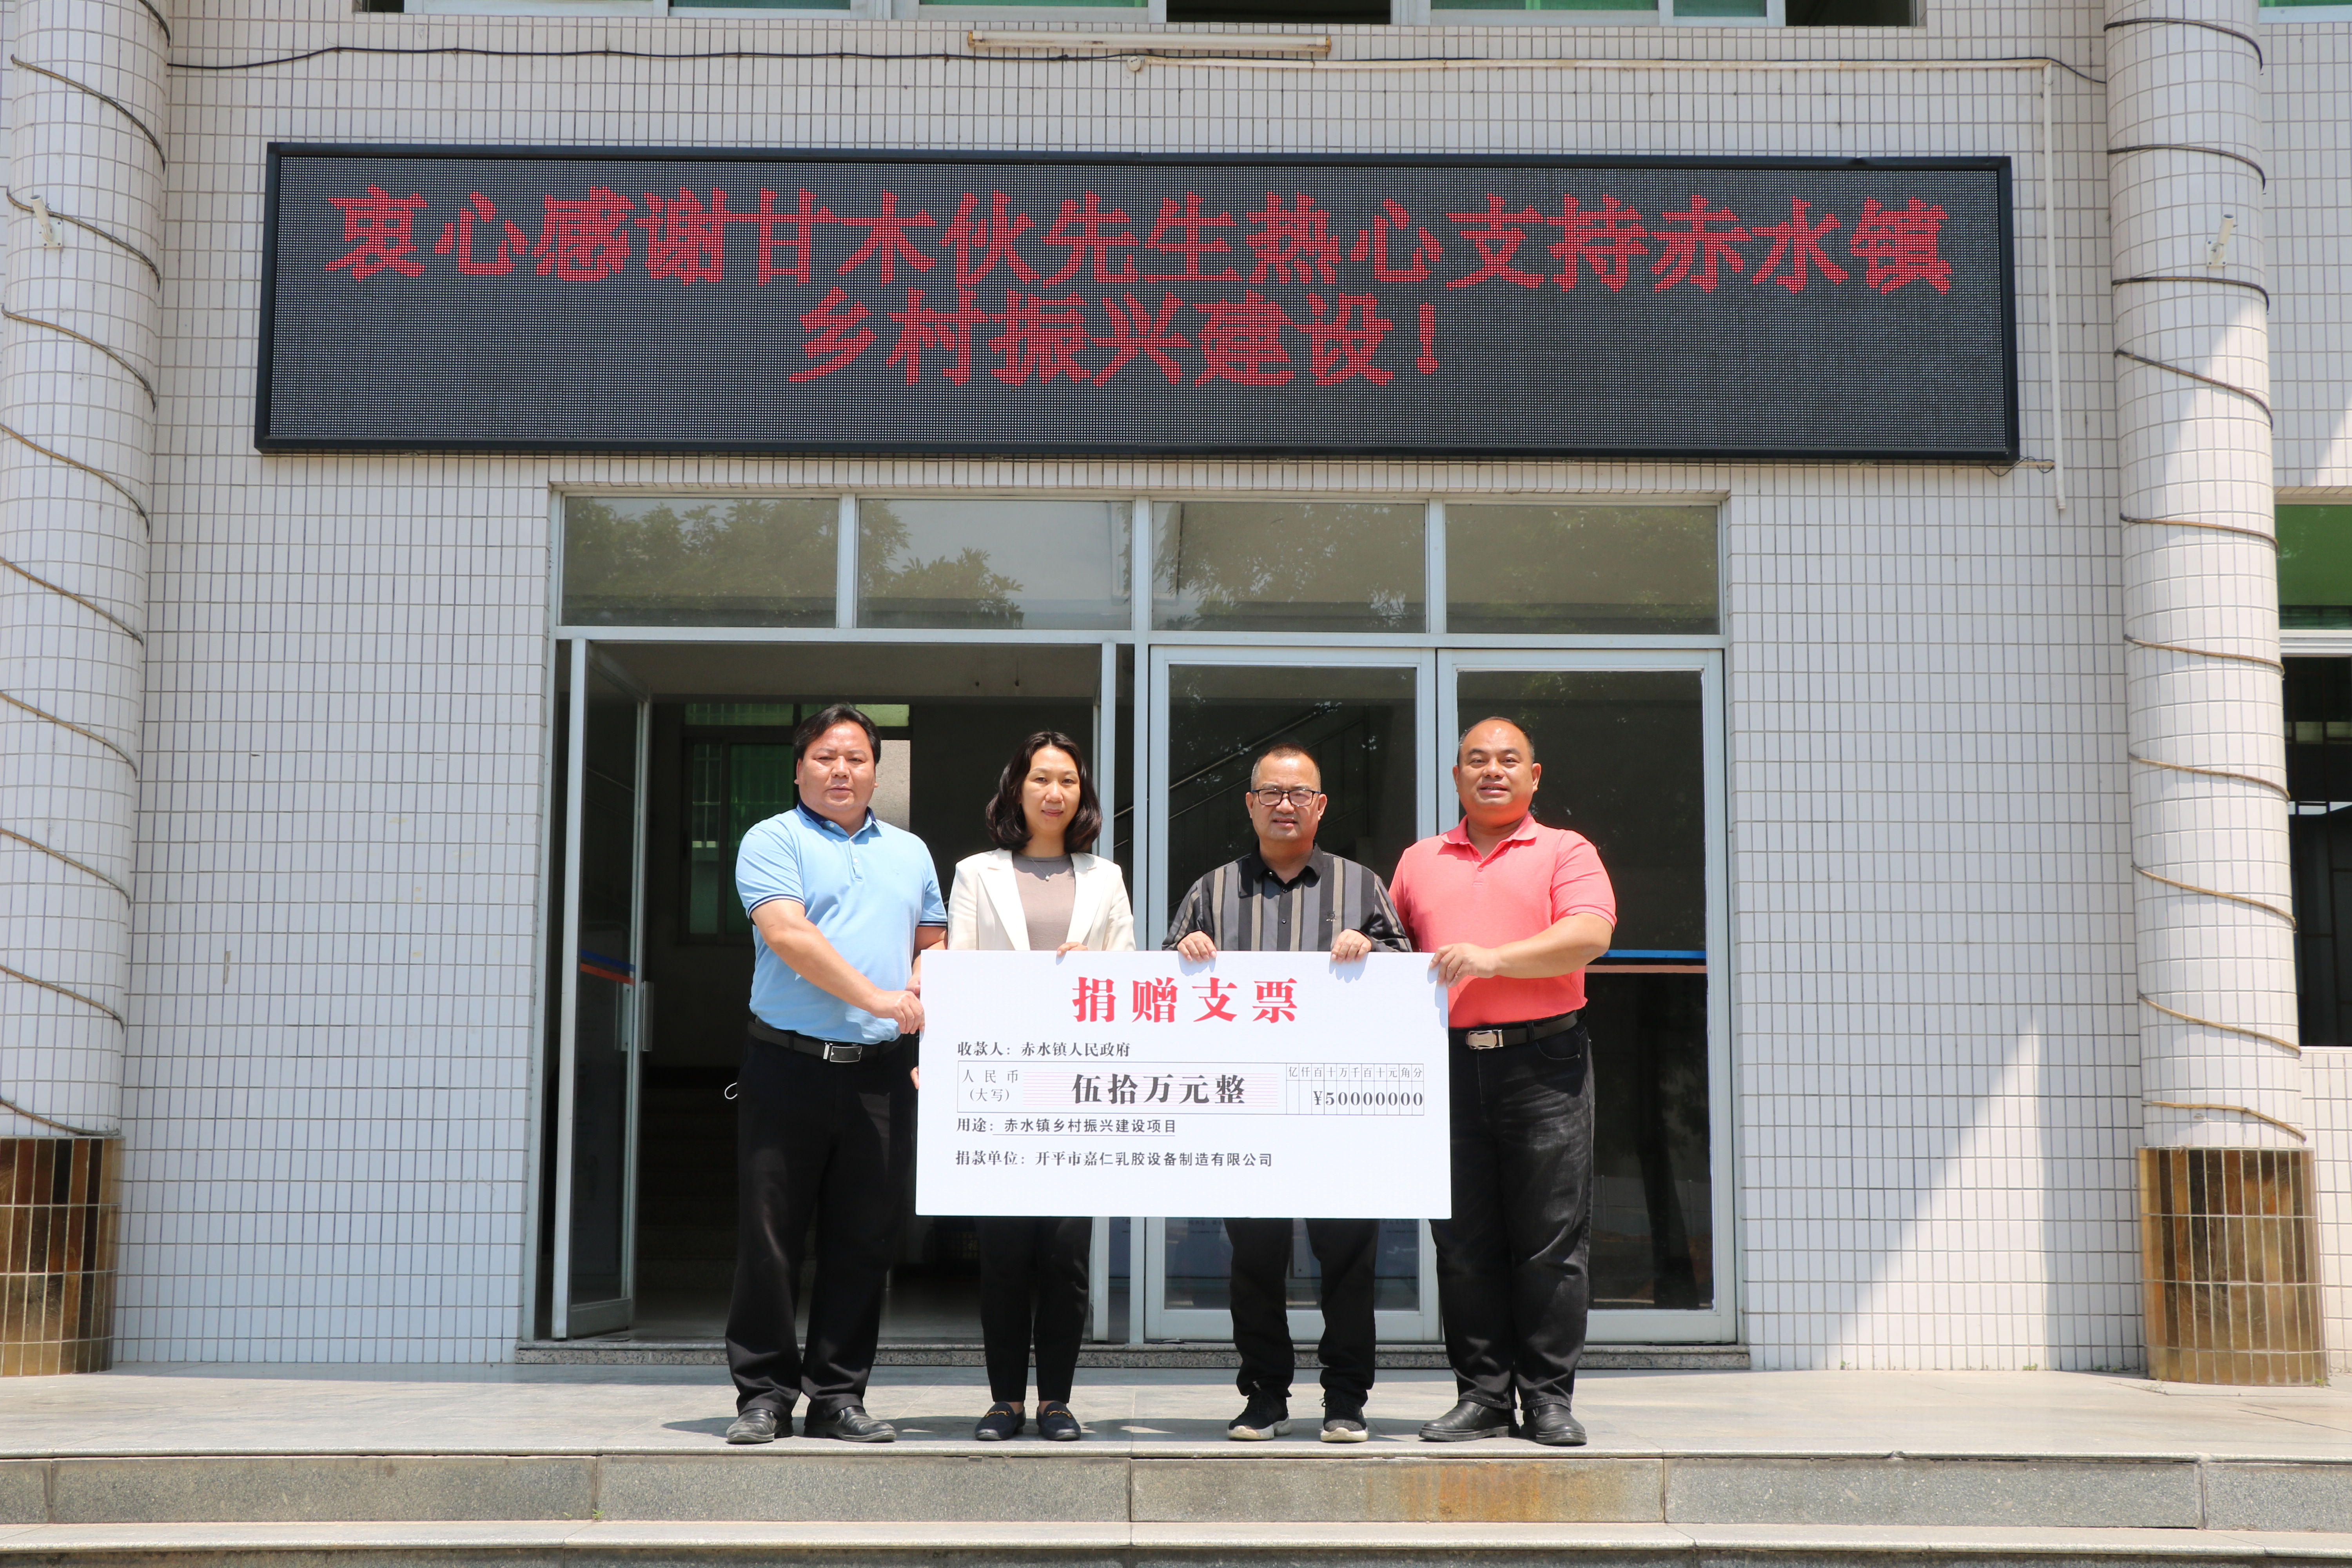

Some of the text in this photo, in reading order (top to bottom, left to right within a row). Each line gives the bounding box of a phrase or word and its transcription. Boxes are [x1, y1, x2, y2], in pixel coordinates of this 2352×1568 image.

[324, 183, 1953, 295] 衷心感谢甘木伙先生热心支持赤水镇
[1072, 976, 1298, 1024] 捐赠支票
[957, 1041, 1131, 1057] 收款人：赤水镇人民政府
[962, 1069, 1019, 1083] 人民币
[1071, 1073, 1245, 1104] 伍拾万元整
